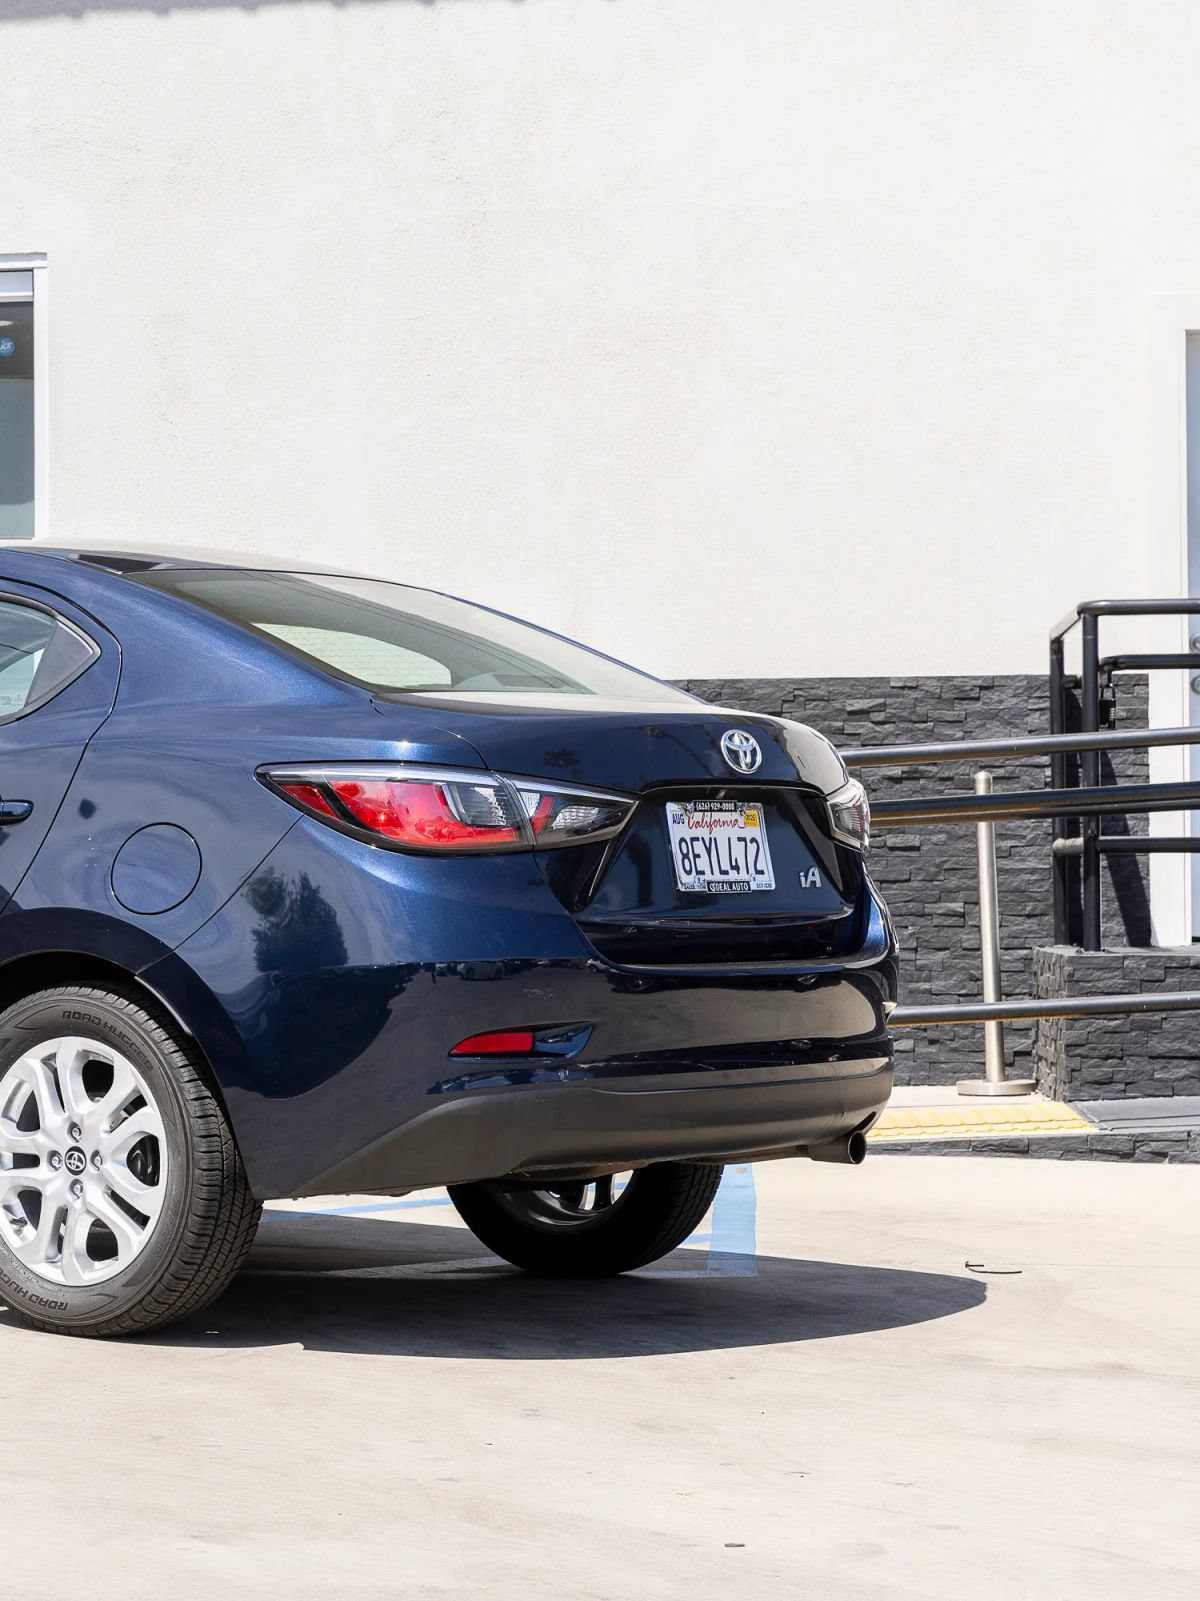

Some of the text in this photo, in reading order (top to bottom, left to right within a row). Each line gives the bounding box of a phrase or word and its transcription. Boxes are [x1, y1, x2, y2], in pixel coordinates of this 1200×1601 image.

[672, 813, 685, 825] AUG
[687, 811, 741, 834] California
[678, 836, 766, 876] 8EYL472
[732, 881, 749, 891] AUTO
[799, 866, 822, 888] iA
[62, 1010, 154, 1072] ROAD HUGGER
[28, 1294, 69, 1311] ROAD
